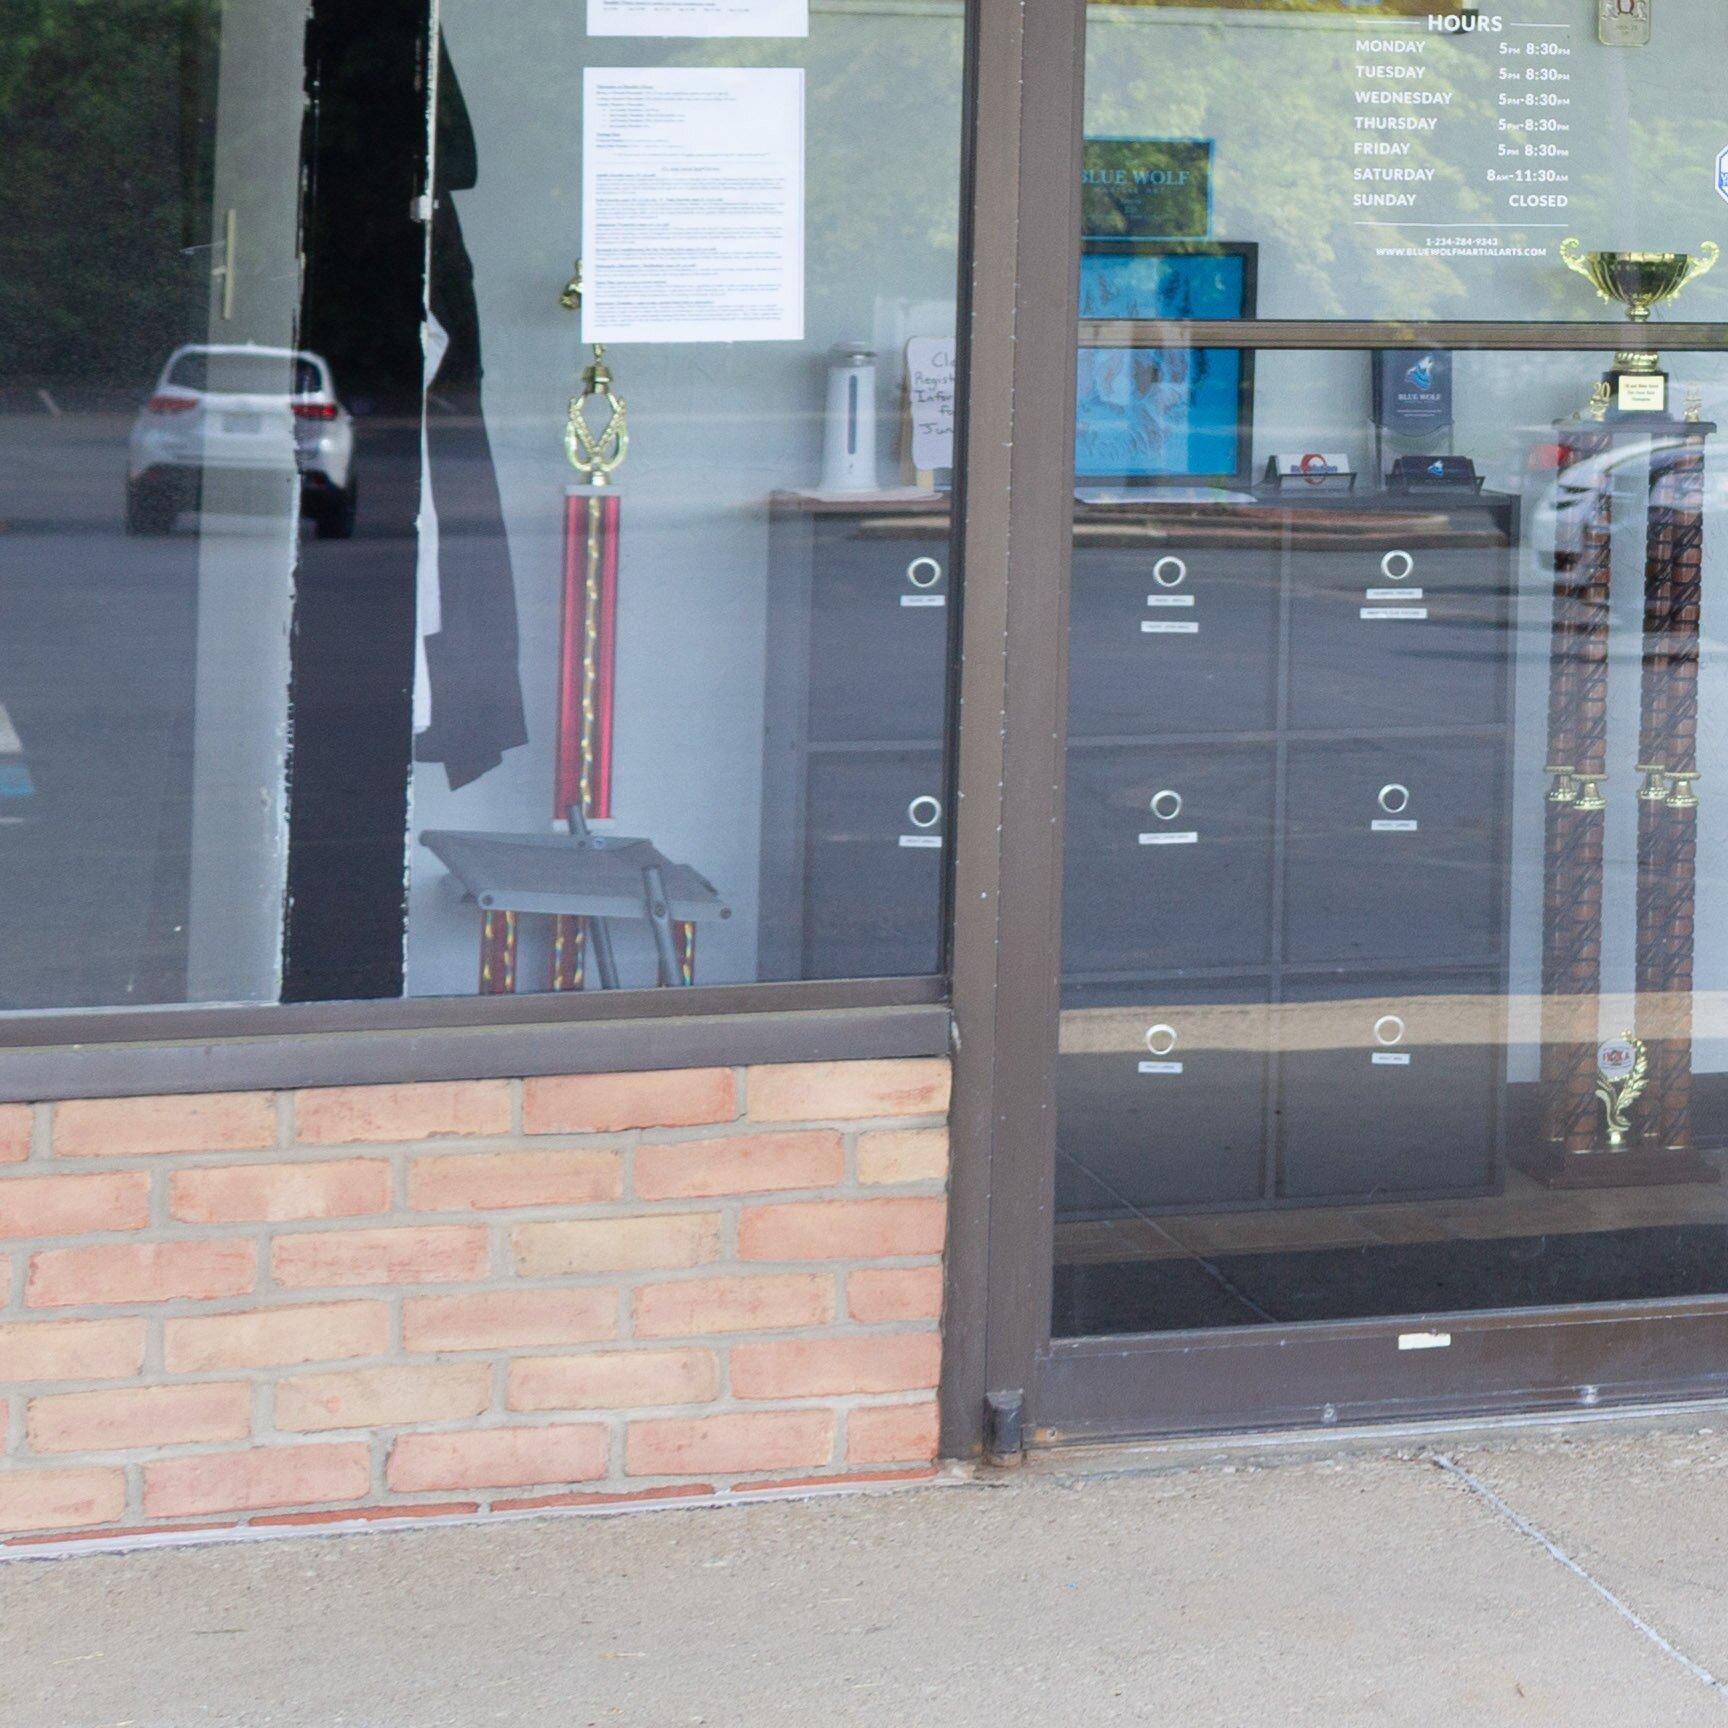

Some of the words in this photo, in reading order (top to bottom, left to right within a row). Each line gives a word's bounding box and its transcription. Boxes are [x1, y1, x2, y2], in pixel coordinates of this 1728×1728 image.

[1427, 14, 1503, 32] HOURS
[1355, 40, 1426, 53] MONDAY
[1355, 65, 1426, 79] TUESDAY
[1355, 91, 1452, 104] WEDNESDAY
[1354, 117, 1438, 130] THURSDAY
[1354, 142, 1411, 156] FRIDAY
[1132, 169, 1190, 186] WOLF
[1353, 168, 1435, 181] SATURDAY
[1353, 193, 1417, 207] SUNDAY
[1509, 194, 1568, 207] CLOSED
